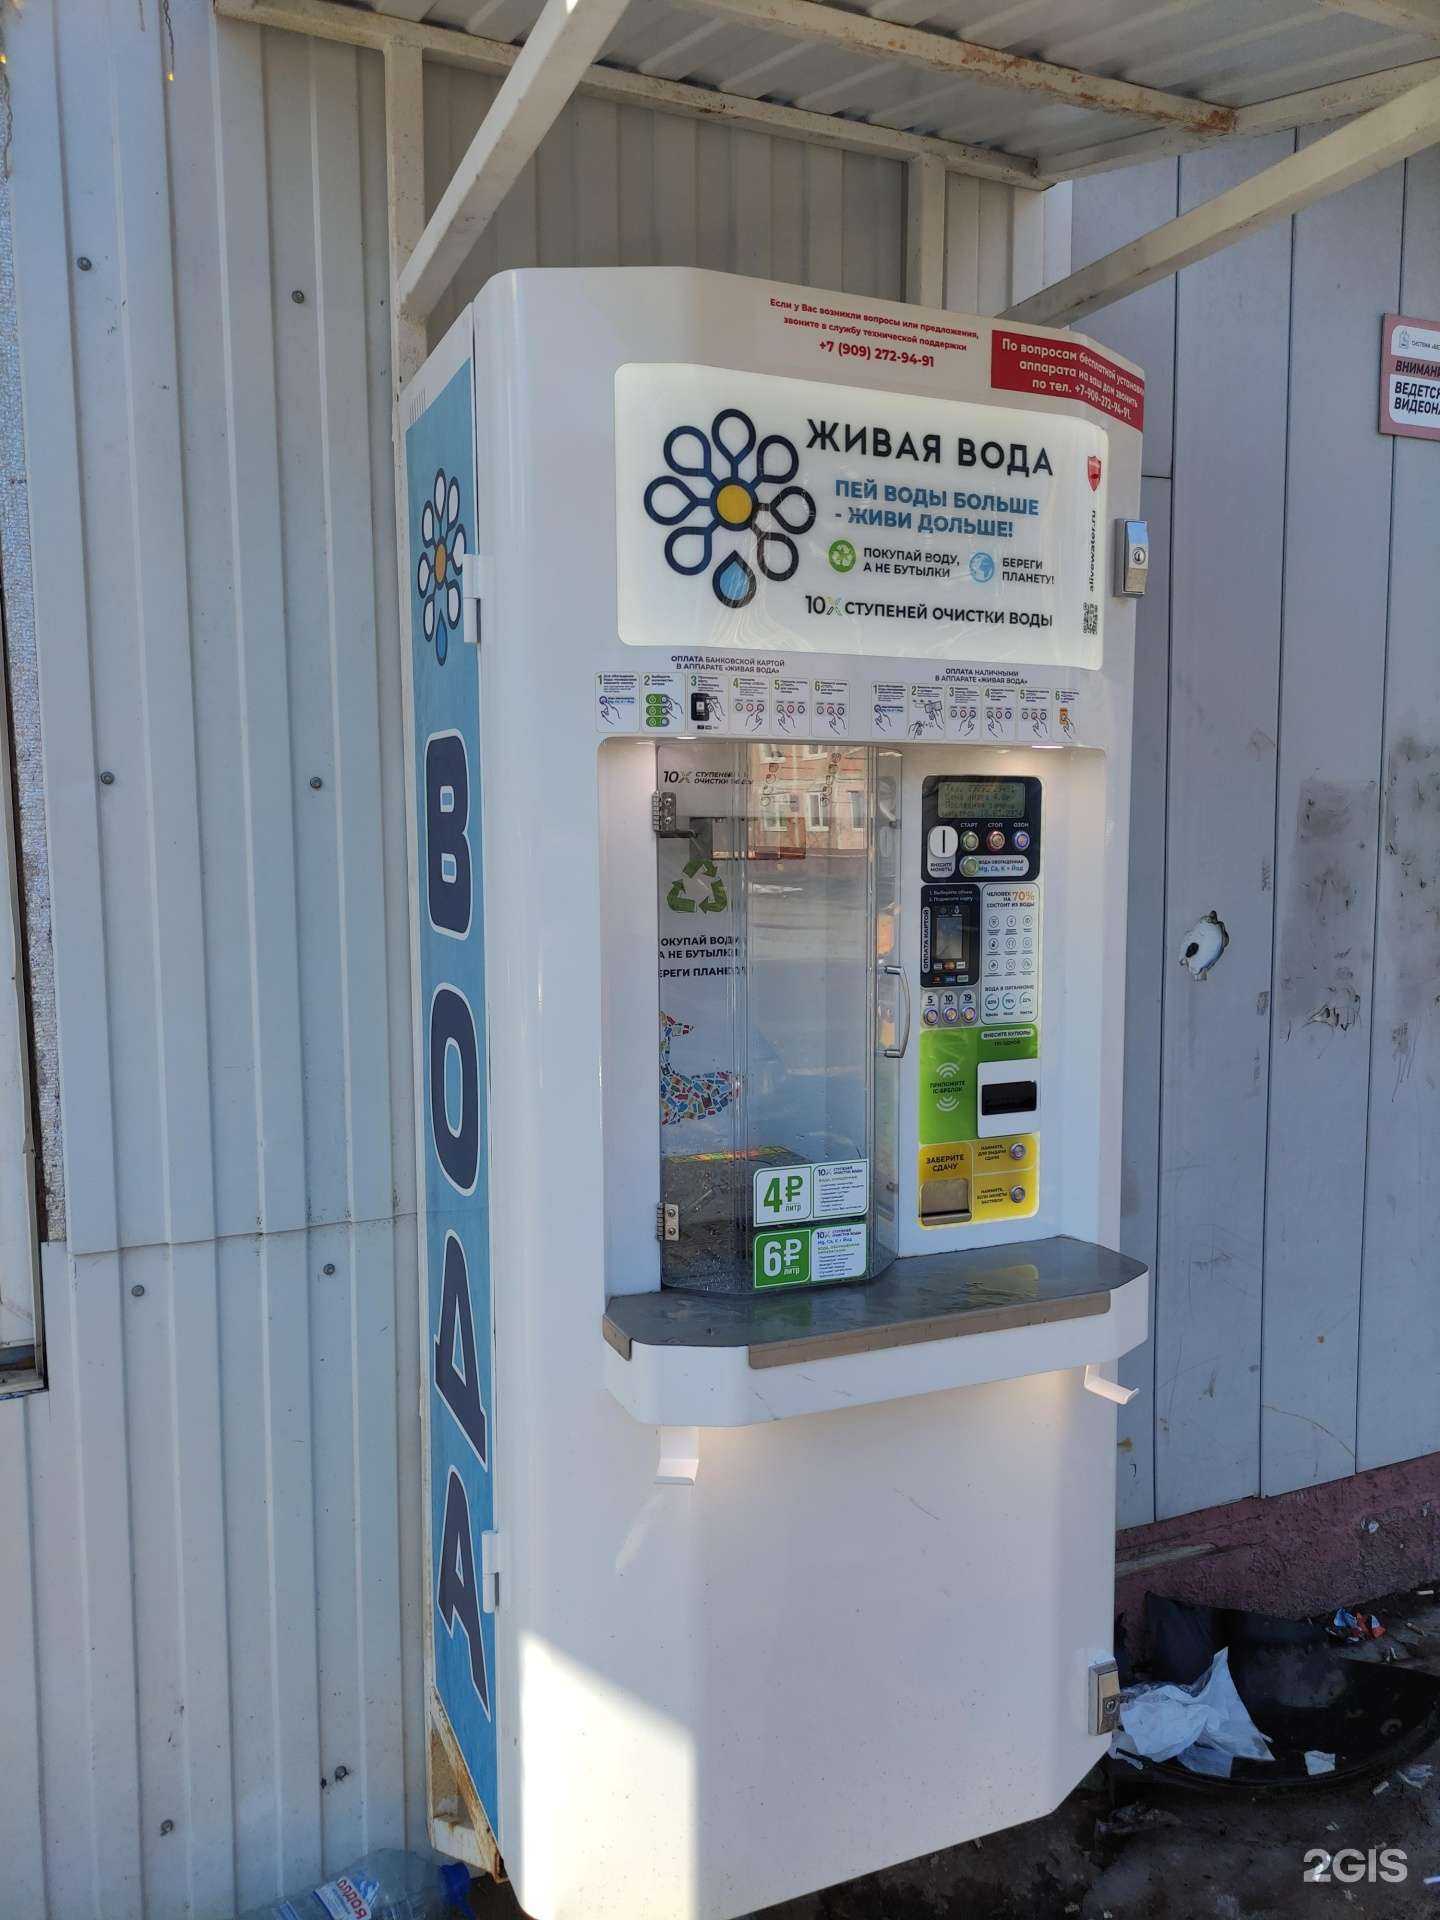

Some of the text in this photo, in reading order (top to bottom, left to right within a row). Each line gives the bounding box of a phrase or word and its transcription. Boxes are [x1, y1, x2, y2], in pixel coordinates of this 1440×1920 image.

[769, 298, 979, 340] Если у Вас возникли вопросы или предложения,
[784, 317, 819, 329] звоните
[829, 323, 861, 338] службу
[863, 328, 918, 345] технической
[919, 337, 967, 351] поддержки
[819, 340, 935, 368] +7 (909) 272-94-91
[1002, 338, 1018, 351] По
[1020, 344, 1077, 361] вопросам
[1079, 352, 1116, 380] бесплатной
[1019, 360, 1138, 408] аппарата на ваш дом звонить
[1032, 378, 1047, 389] по
[1049, 381, 1072, 393] тел.
[806, 419, 1053, 477] ЖИВАЯ ВОДА
[835, 478, 1040, 517] ПЕЙ ВОДЫ БОЛЬШЕ
[848, 507, 912, 529] ЖИВИ
[917, 512, 1014, 538] ДОЛЬШЕ!
[863, 547, 961, 568] ПОКУПАЙ ВОДУ,
[1002, 556, 1043, 570] БЕРЕГИ
[863, 562, 951, 579] А НЕ БУТЫЛКИ
[1001, 571, 1055, 586] ПЛАНЕТУ!
[845, 599, 928, 620] СТУПЕНЕЙ
[932, 606, 1005, 625] ОЧИСТКИ
[1009, 611, 1053, 628] ВОДЫ
[671, 655, 785, 668] ОПЛАТА БАНКОВСКОЙ КАРТОЙ
[682, 663, 723, 671] АППАРАТЕ
[724, 665, 755, 673] «ЖИВАЯ
[756, 666, 780, 674] ВОДА»
[945, 668, 1019, 677] ОПЛАТА НАЛИЧНЫМИ
[597, 675, 603, 685] 1
[644, 675, 651, 686] 2
[690, 675, 697, 687] 3
[733, 678, 739, 688] 4
[774, 679, 780, 690] 5
[814, 680, 821, 691] 6
[872, 685, 878, 694] 1
[911, 686, 917, 696] 2
[949, 687, 955, 697] 3
[984, 689, 990, 699] 4
[1020, 689, 1026, 699] 5
[1055, 690, 1061, 700] 6
[1013, 889, 1035, 901] 70%
[668, 950, 683, 959] НЕ
[927, 996, 933, 1004] 5
[944, 994, 953, 1002] 10
[963, 993, 972, 1001] 19
[930, 1080, 965, 1088] ПРИЛОЖИТЕ
[927, 1154, 964, 1164] ЗАБЕРИТЕ
[932, 1162, 958, 1172] СДАЧУ
[785, 1204, 802, 1213] литр
[424, 728, 491, 1723] ВОДА
[784, 1267, 800, 1276] литр
